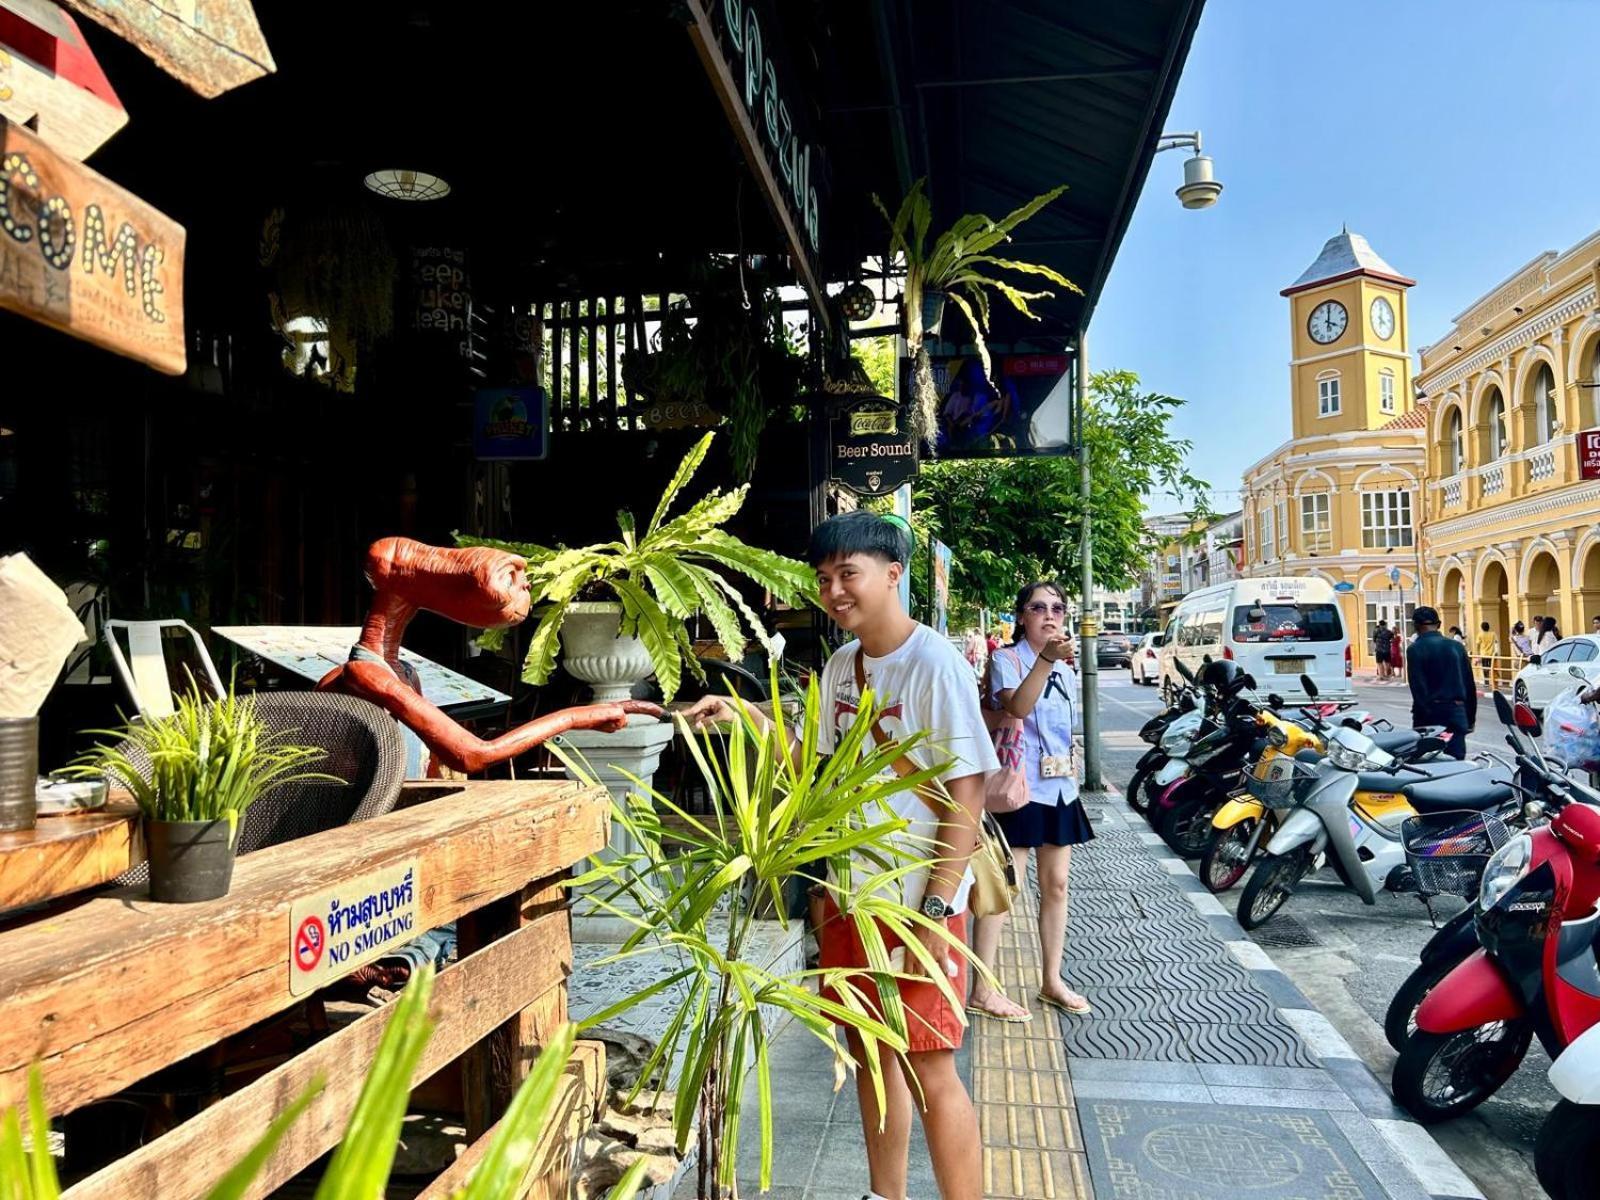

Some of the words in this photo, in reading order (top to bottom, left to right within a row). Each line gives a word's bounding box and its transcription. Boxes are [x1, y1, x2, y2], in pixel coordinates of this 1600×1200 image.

[838, 445, 869, 458] Beer
[870, 443, 912, 457] Sound
[328, 867, 413, 937] ห้ามสูบบุหรี่
[328, 941, 350, 968] NO
[354, 912, 413, 955] SMOKING
